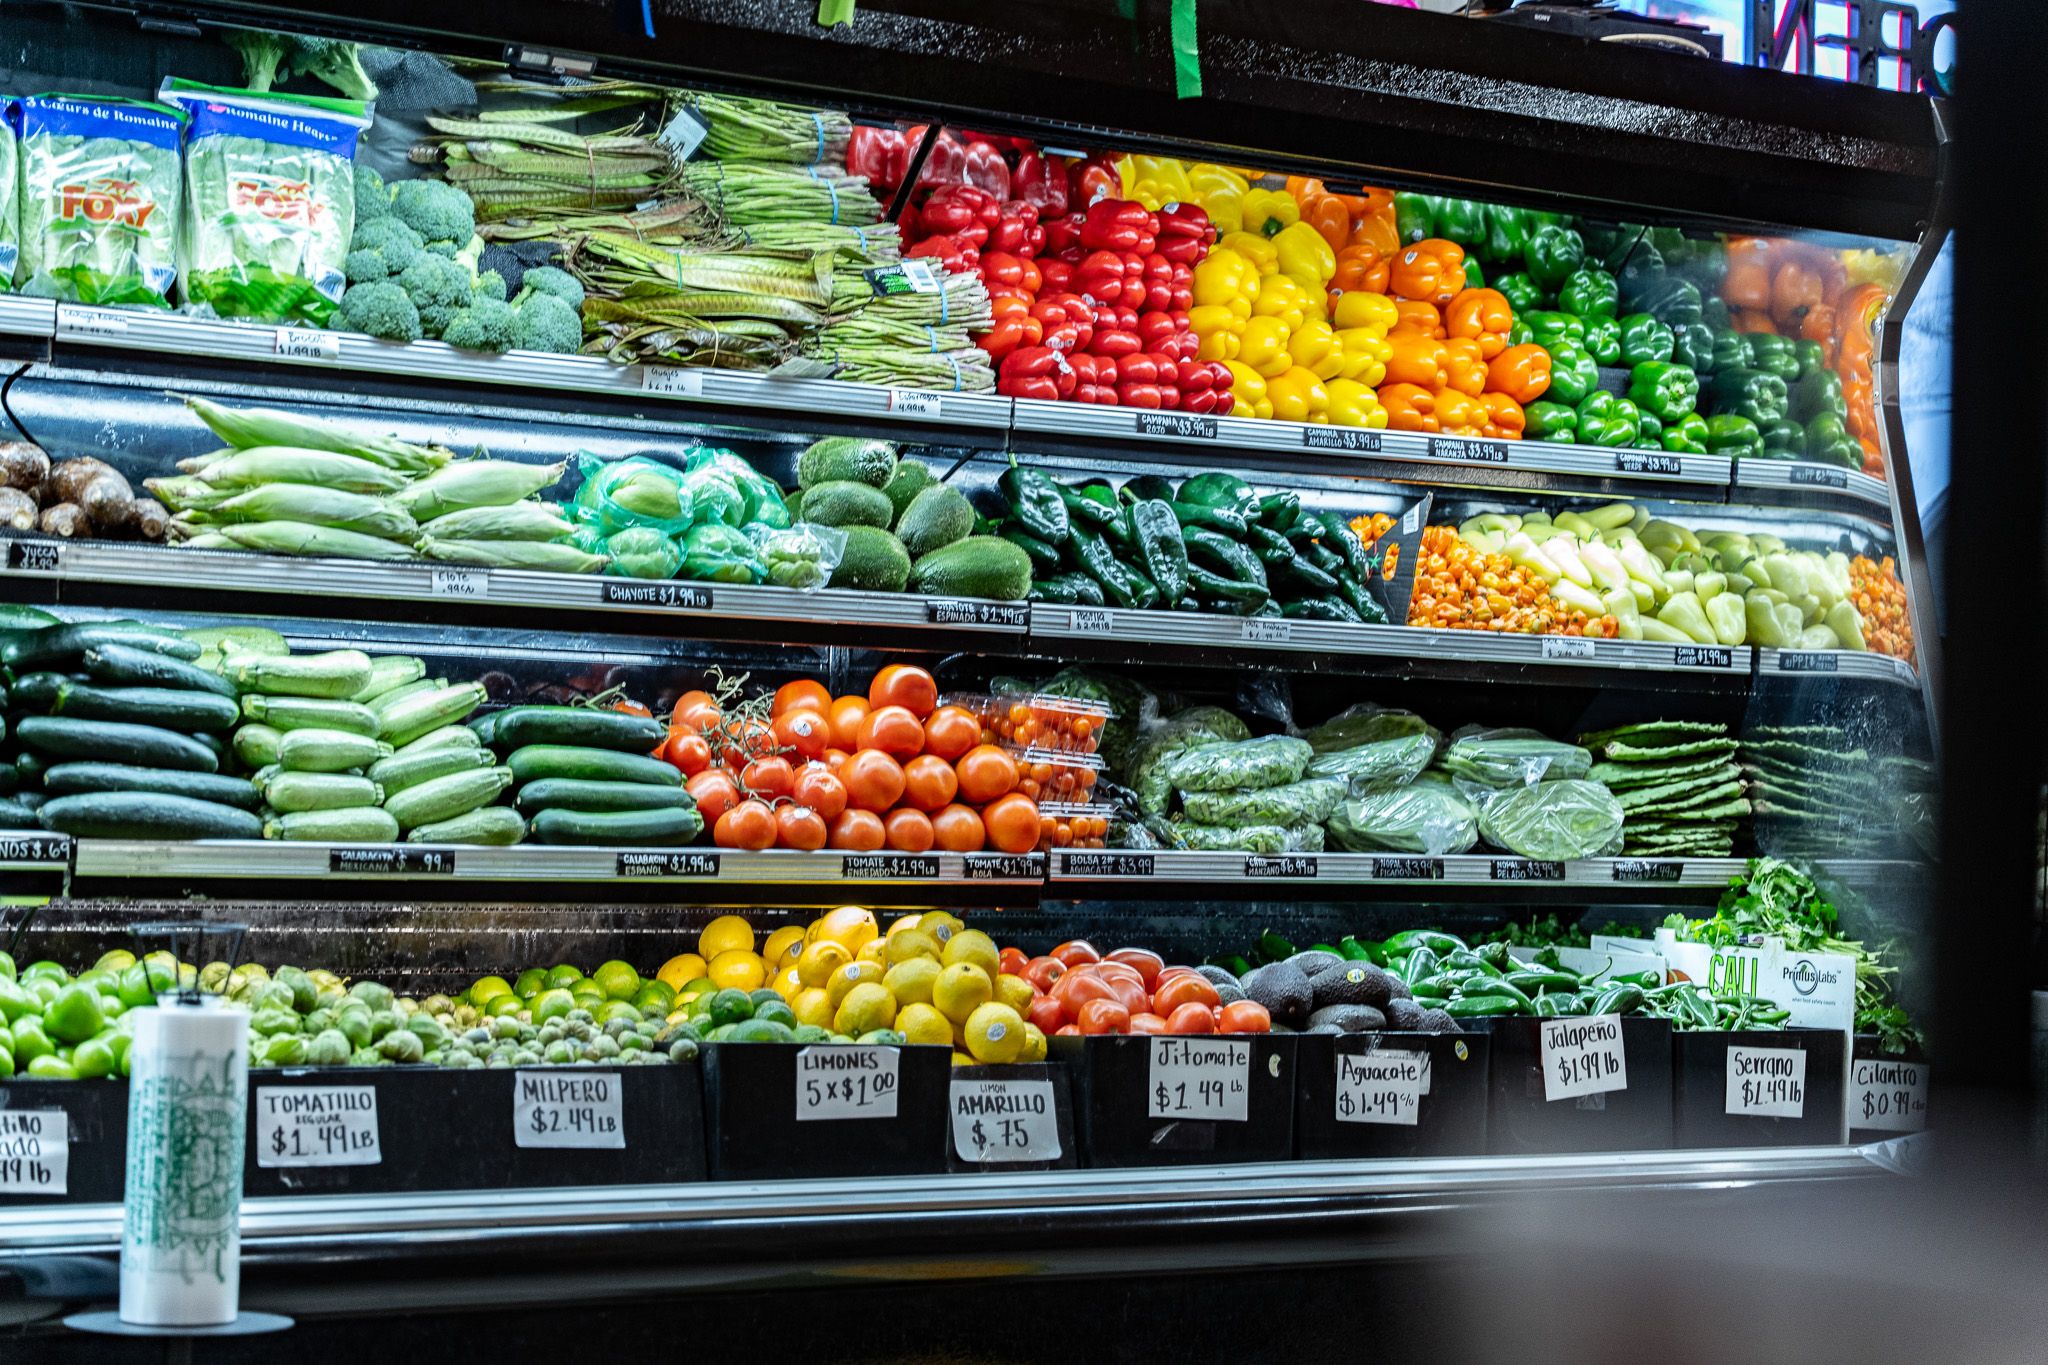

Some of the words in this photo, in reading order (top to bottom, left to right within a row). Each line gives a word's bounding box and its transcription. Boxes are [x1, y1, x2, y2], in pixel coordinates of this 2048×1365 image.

[93, 107, 109, 120] de
[114, 110, 178, 131] Romaine
[63, 184, 156, 228] FOXY
[1141, 414, 1178, 427] CAMPANA
[1146, 424, 1165, 435] ROJO
[1308, 437, 1342, 448] AMARILLO
[21, 545, 57, 559] YUCCA
[610, 586, 656, 601] CHAYOTE
[936, 610, 976, 623] ESPINADO
[623, 853, 668, 865] CALABACIN
[847, 856, 885, 868] TOMATE
[967, 858, 1001, 869] TOMATE
[1070, 855, 1099, 866] BOLSA
[1380, 858, 1401, 868] NOPAL
[1496, 861, 1520, 870] NOPAL
[340, 861, 390, 873] MEXICANA
[847, 867, 890, 878] ENREDADO
[972, 868, 993, 879] BOLA
[1069, 865, 1113, 875] AGUACATE
[1248, 865, 1280, 877] MANZANO
[1497, 868, 1526, 879] PELADO
[1546, 1021, 1617, 1051] Jalapeño
[1158, 1040, 1247, 1066] Jitomate
[804, 1051, 879, 1071] LIMONES
[1558, 1050, 1600, 1086] $1.99
[1603, 1050, 1620, 1075] lb
[1734, 1050, 1793, 1079] Serrano
[1341, 1054, 1418, 1086] Aguacate
[1857, 1062, 1917, 1086] Cilantro
[522, 1078, 608, 1103] MILPERO
[980, 1083, 1007, 1094] LIMON
[1741, 1078, 1787, 1108] $1.49
[1789, 1080, 1802, 1104] lb
[264, 1092, 373, 1114] TOMATILLO
[957, 1094, 1046, 1115] AMARILLO
[1339, 1090, 1398, 1117] $1.49
[1862, 1089, 1910, 1120] $0.99
[0, 1115, 41, 1135] tillo
[295, 1113, 342, 1125] REGULAR
[531, 1105, 595, 1134] $2.49
[598, 1116, 617, 1133] LB
[351, 1129, 374, 1150] LB
